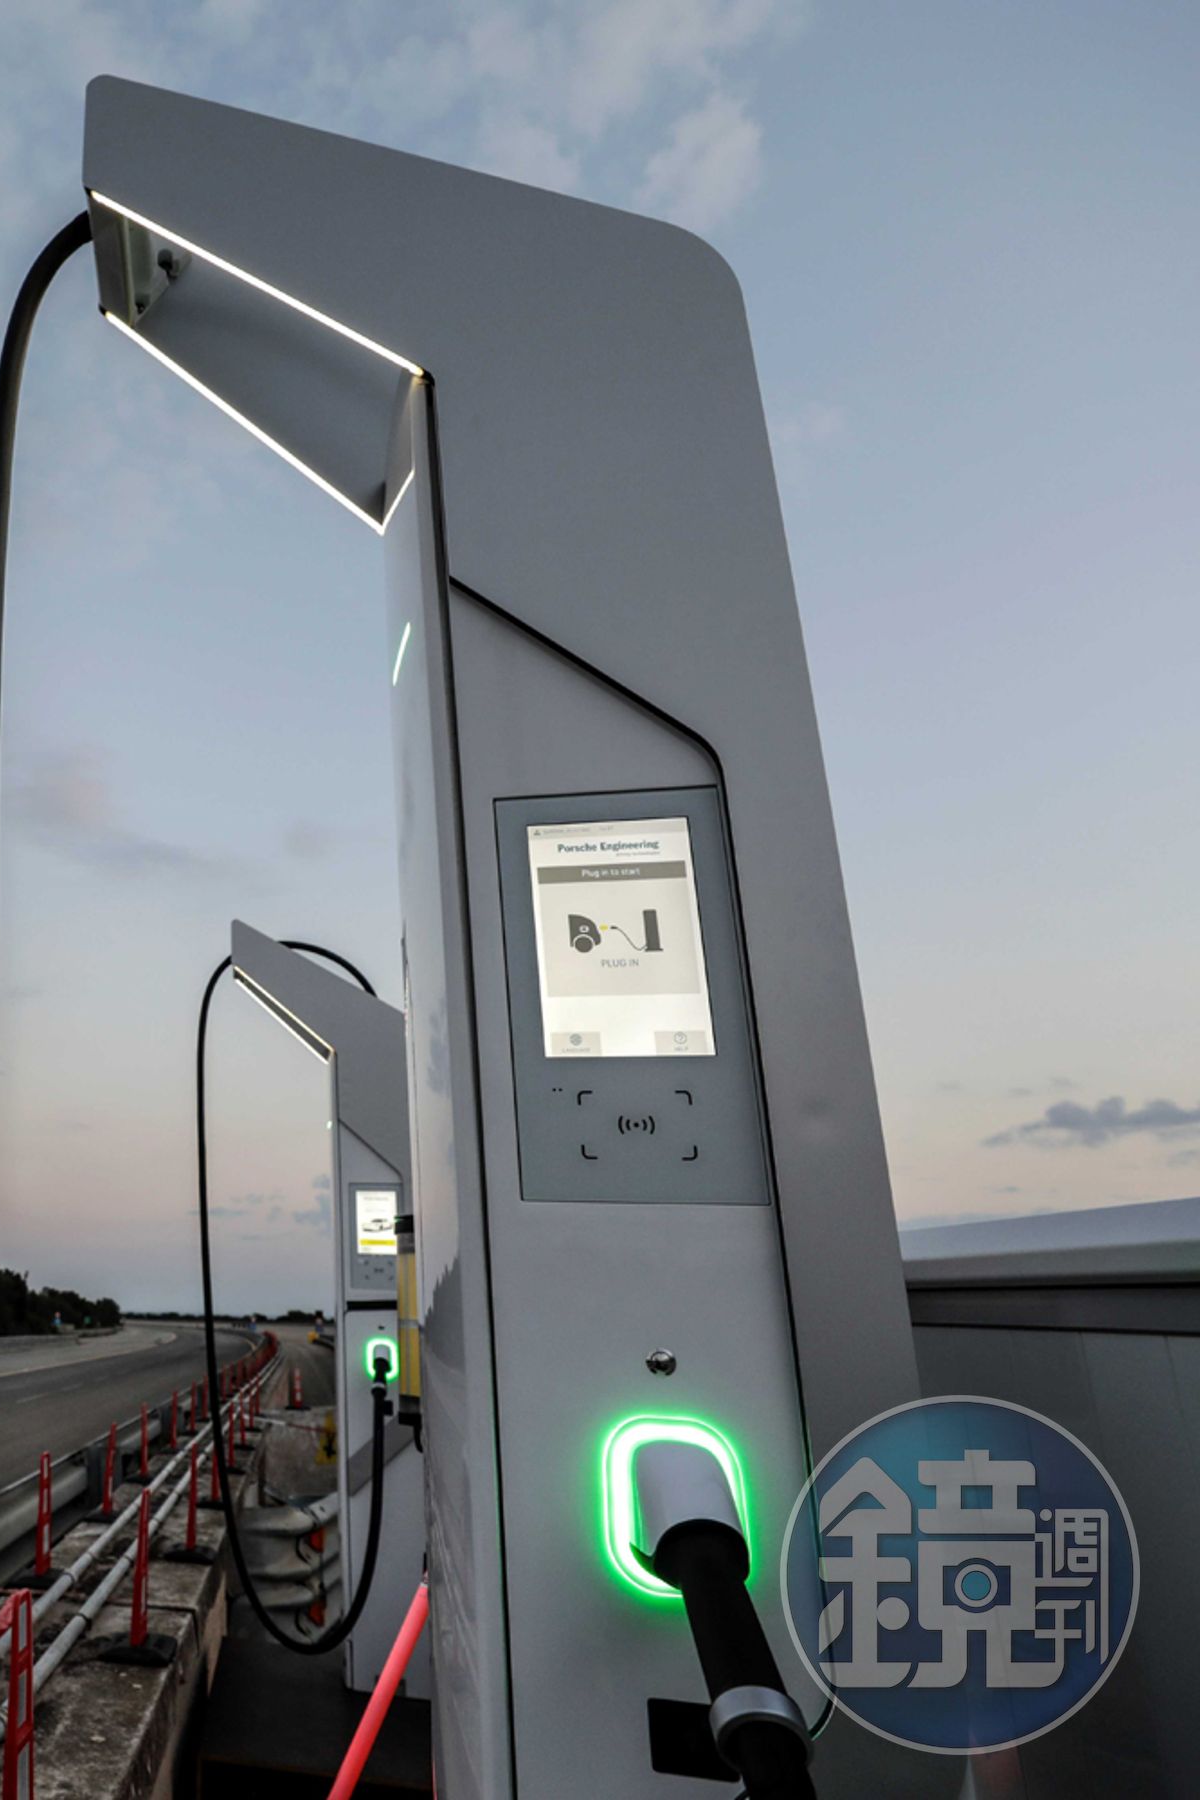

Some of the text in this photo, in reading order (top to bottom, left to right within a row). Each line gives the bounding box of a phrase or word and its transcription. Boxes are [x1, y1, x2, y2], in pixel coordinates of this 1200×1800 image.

[557, 840, 659, 853] Porsche Engineering
[581, 868, 600, 878] Plug
[610, 868, 620, 876] to
[621, 867, 641, 876] start
[601, 958, 640, 968] PLUG IN
